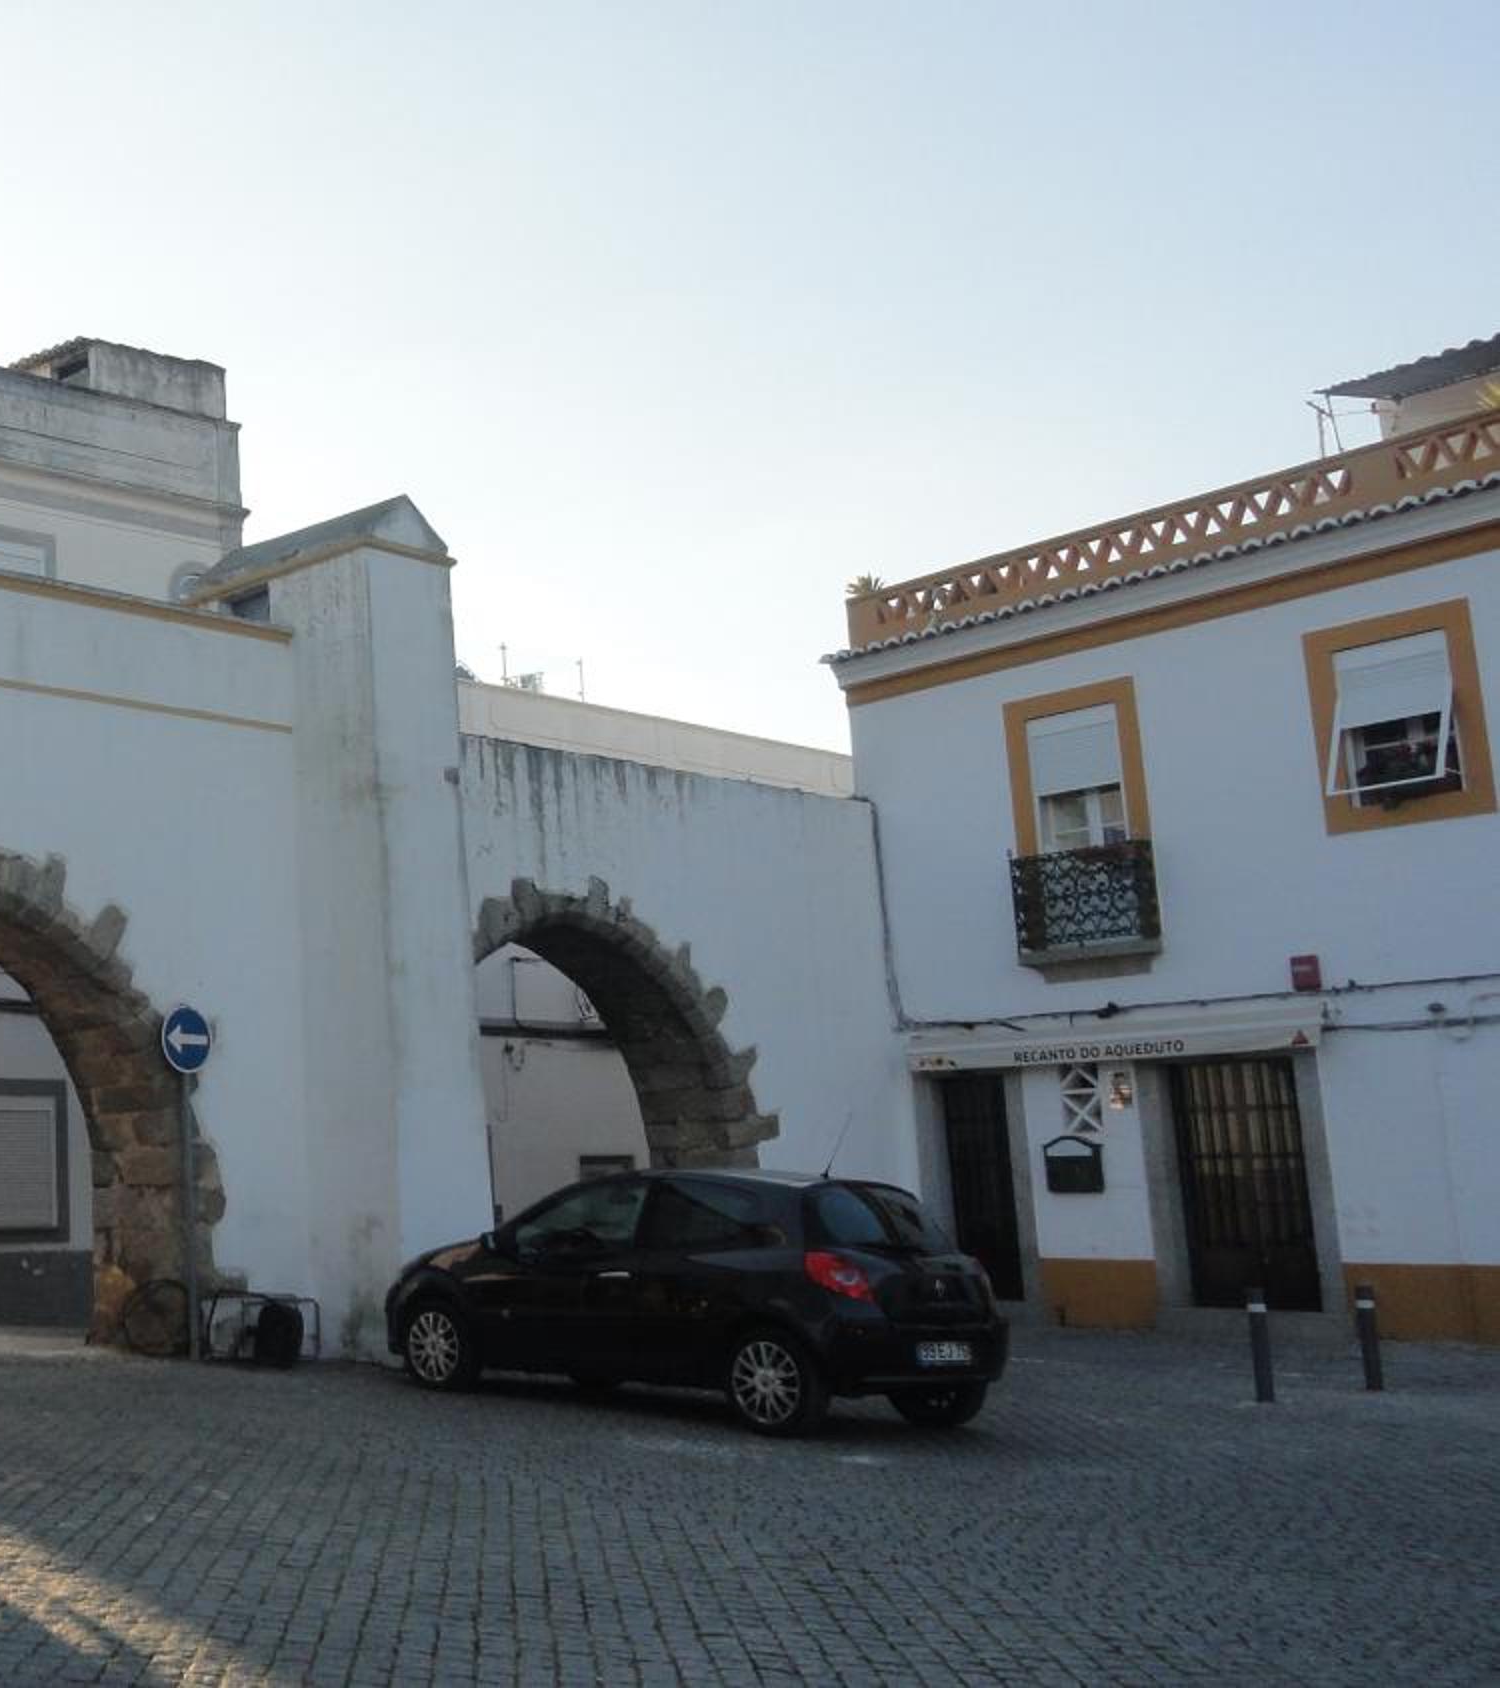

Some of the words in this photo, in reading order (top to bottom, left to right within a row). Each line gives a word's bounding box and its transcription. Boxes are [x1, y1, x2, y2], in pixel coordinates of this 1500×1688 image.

[1014, 1048, 1076, 1063] RECANTO
[1080, 1047, 1100, 1060] DO
[1104, 1039, 1185, 1057] AQUEDUTO
